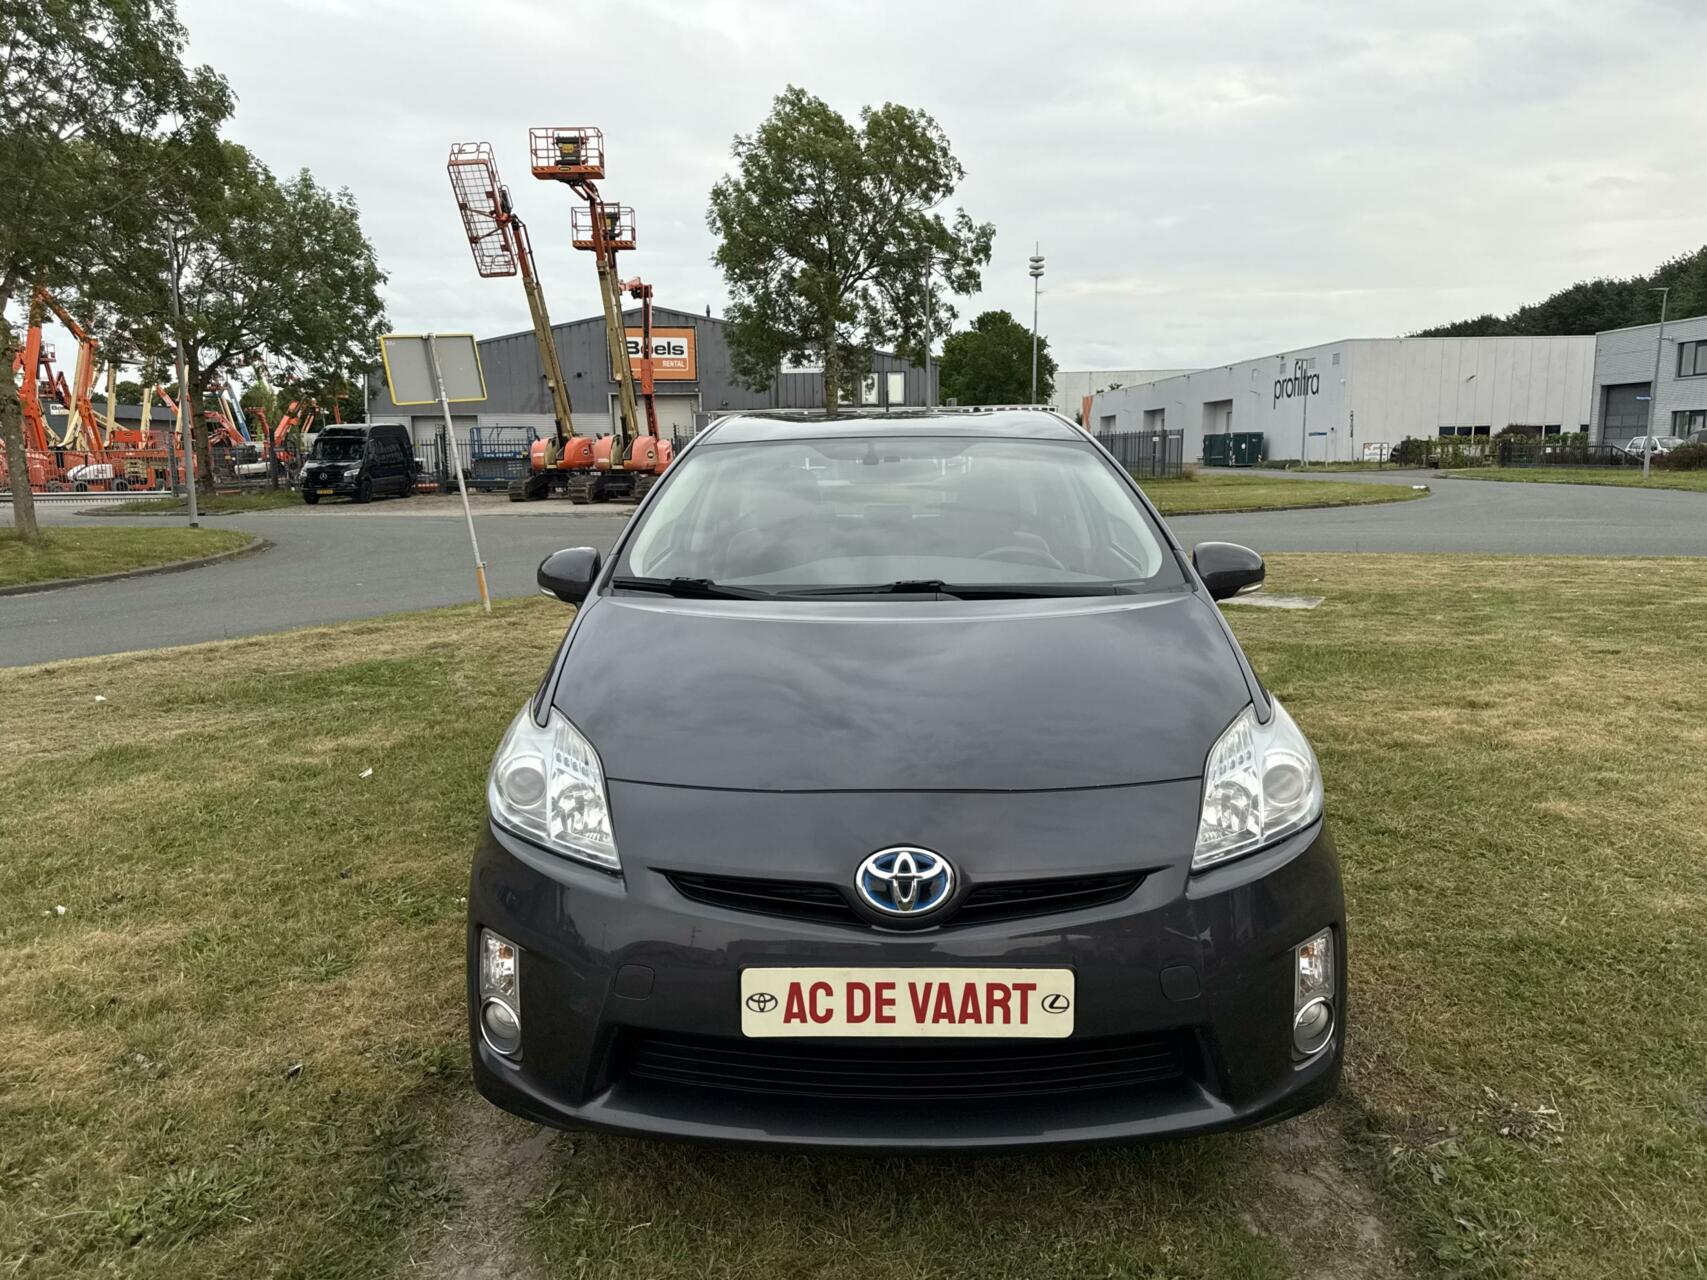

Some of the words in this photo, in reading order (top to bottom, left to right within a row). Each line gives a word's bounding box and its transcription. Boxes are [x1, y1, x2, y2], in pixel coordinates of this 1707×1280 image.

[662, 359, 685, 368] RENTAL
[1273, 360, 1320, 410] profiltra
[783, 981, 834, 1024] AC
[845, 981, 896, 1024] DE
[907, 982, 1037, 1025] VAART
